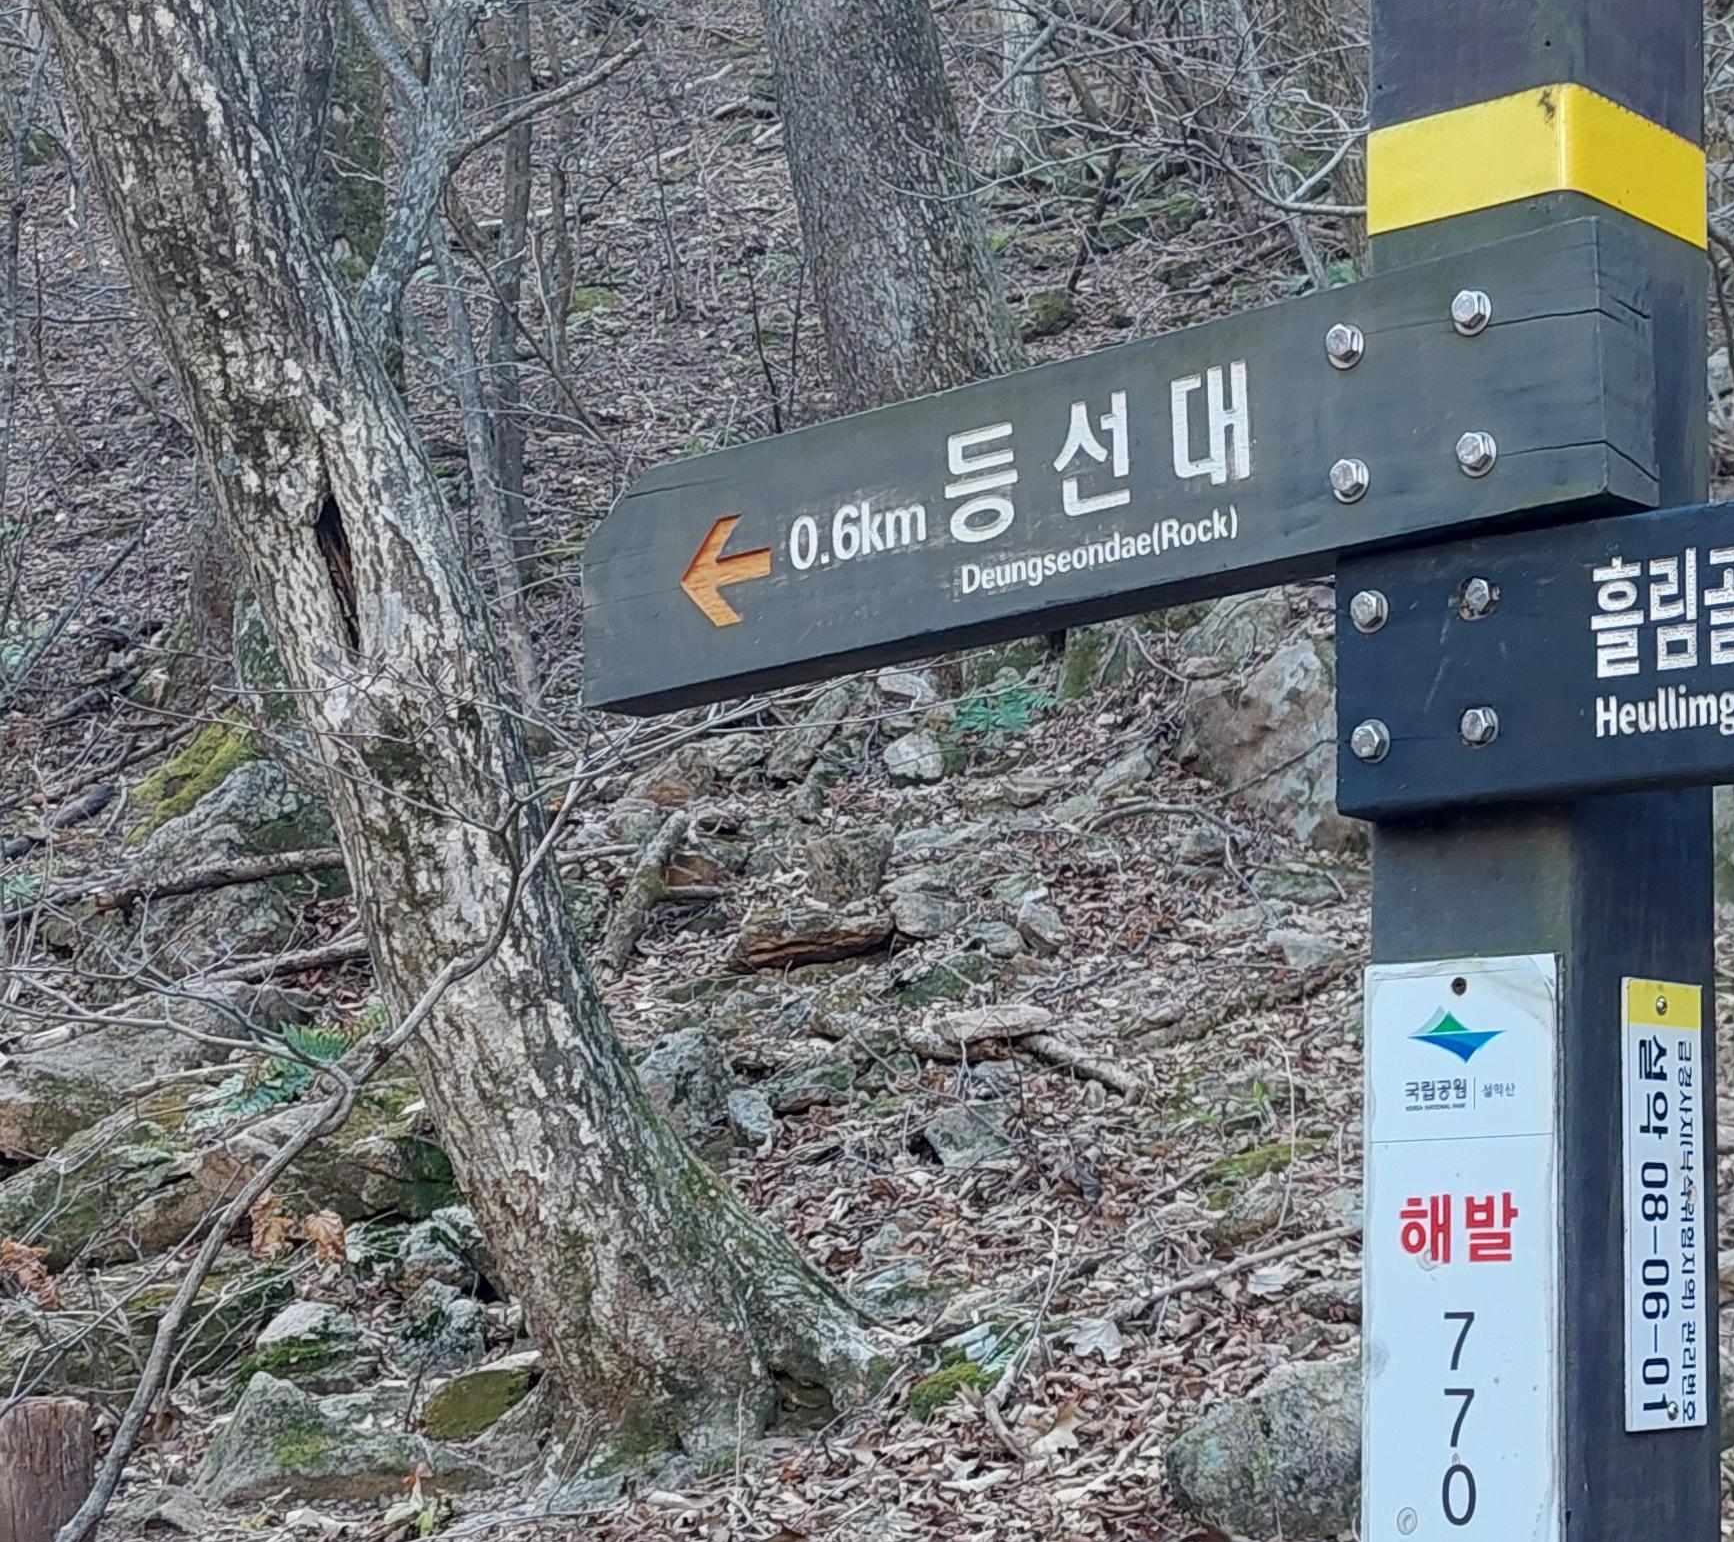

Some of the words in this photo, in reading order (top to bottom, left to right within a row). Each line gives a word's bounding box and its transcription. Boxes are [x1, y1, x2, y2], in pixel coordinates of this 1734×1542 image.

[788, 498, 928, 571] 0.6km
[961, 504, 1239, 595] Deungseondae(Rock)
[1404, 1077, 1467, 1102] 국립공원
[1639, 1034, 1668, 1140] 설악
[1399, 1191, 1519, 1265] 해발
[1641, 1161, 1671, 1412] 08-06-01
[1681, 1320, 1697, 1424] 관리번호
